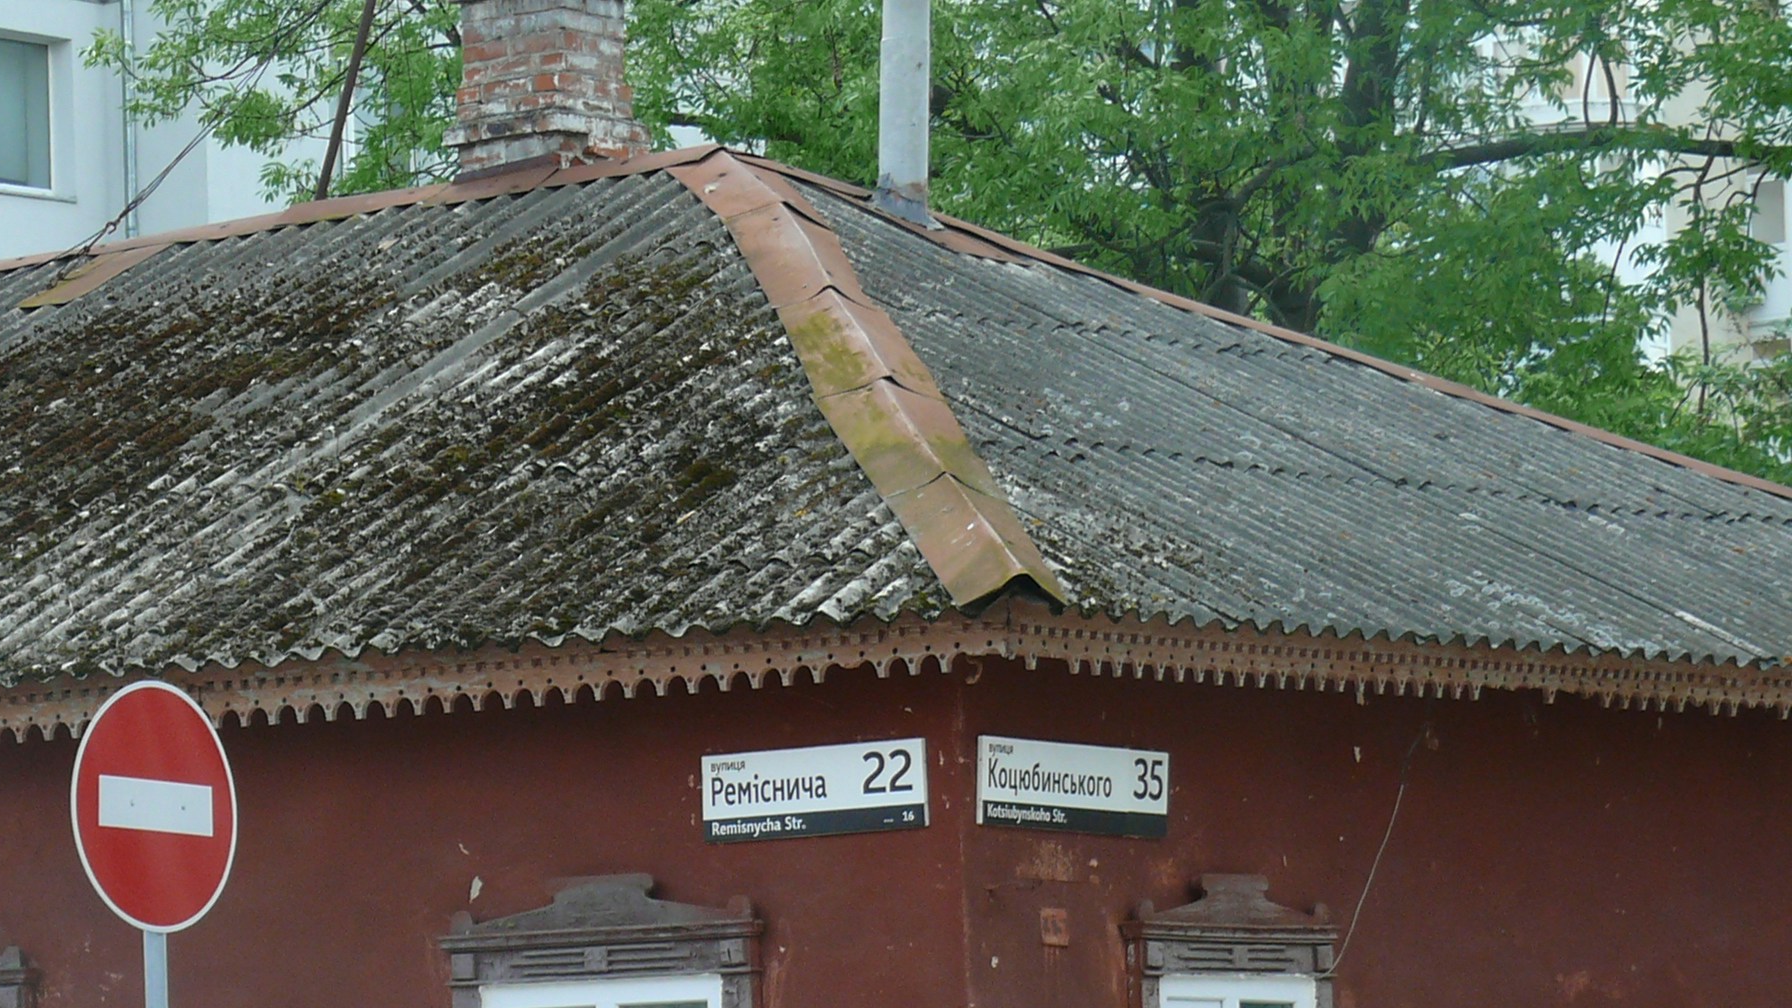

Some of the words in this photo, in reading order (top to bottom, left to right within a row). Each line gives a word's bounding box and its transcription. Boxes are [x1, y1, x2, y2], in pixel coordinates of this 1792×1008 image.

[988, 743, 1014, 757] вулиця
[710, 760, 746, 775] вулиця
[862, 749, 913, 795] 22
[988, 757, 1112, 798] Коцюбинського
[711, 774, 827, 806] Реміснича
[1133, 758, 1163, 801] 35
[901, 810, 915, 822] 16
[987, 803, 1051, 824] Kotsiubynskoho
[1052, 808, 1068, 824] Str.
[711, 818, 781, 838] Remisnycha
[784, 816, 807, 831] Str.
